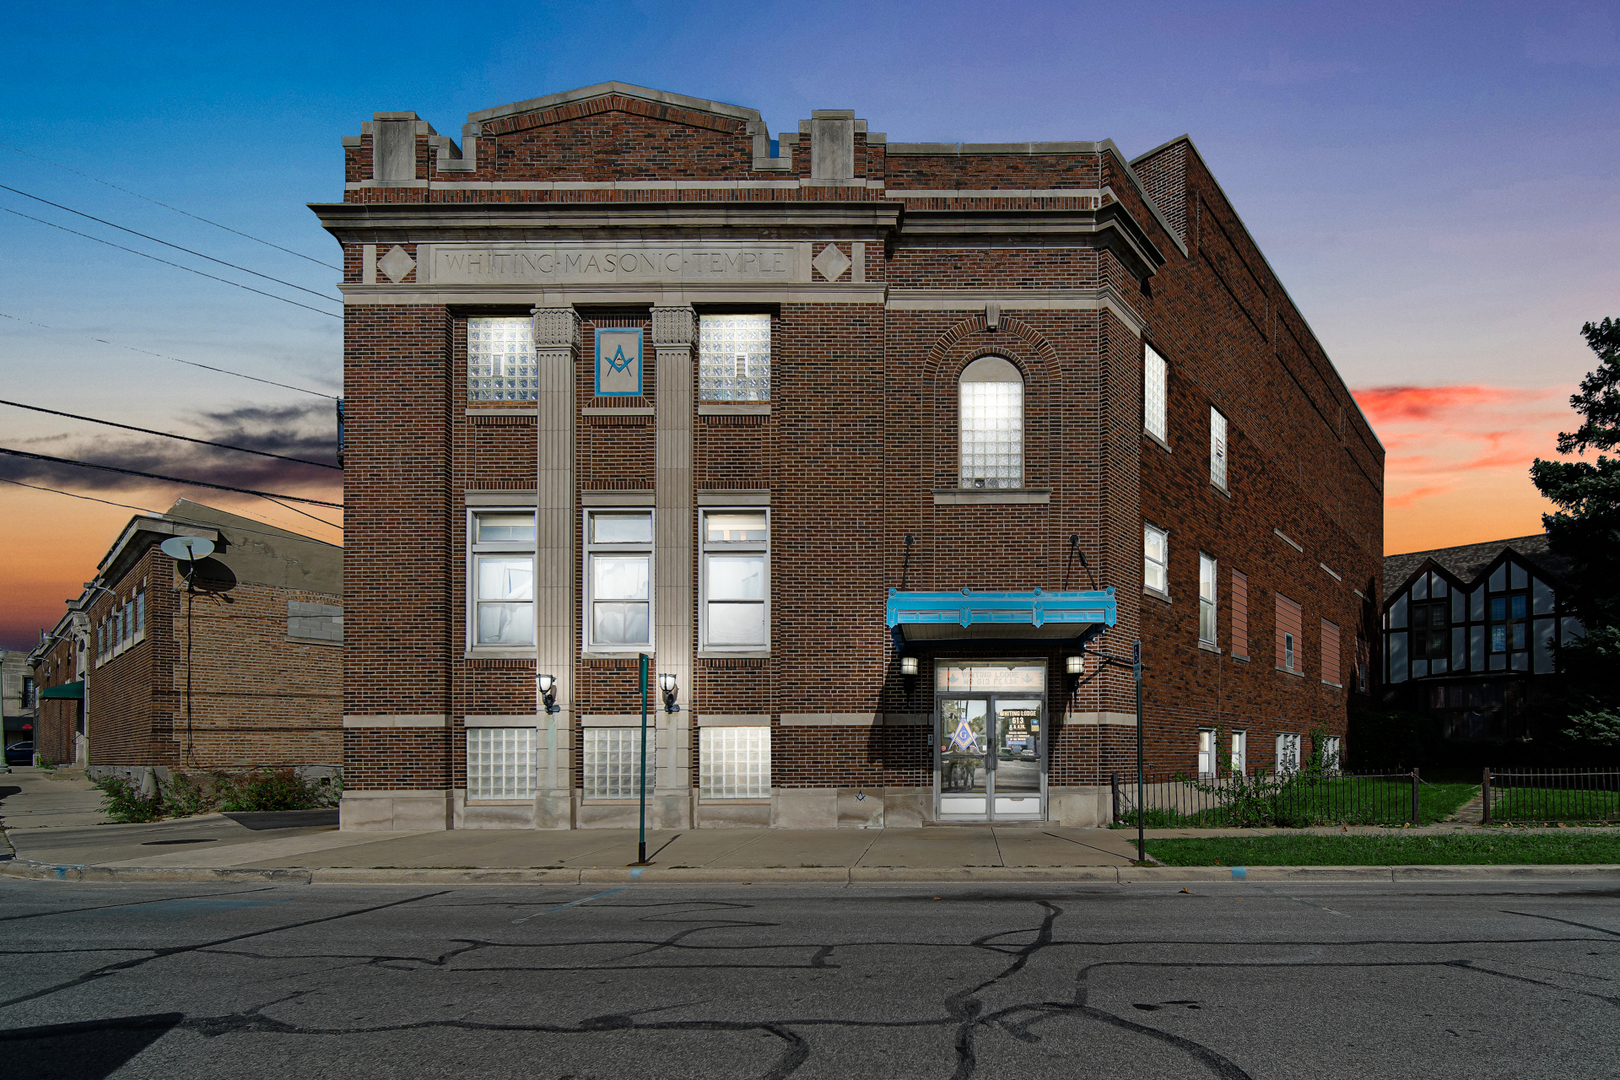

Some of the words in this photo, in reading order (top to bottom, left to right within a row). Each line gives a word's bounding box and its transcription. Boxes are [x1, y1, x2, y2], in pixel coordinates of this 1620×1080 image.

[445, 254, 553, 274] WHITING
[565, 254, 680, 273] MASONIC
[692, 253, 786, 272] TEMPLE
[1012, 716, 1024, 724] 613
[959, 730, 967, 739] G
